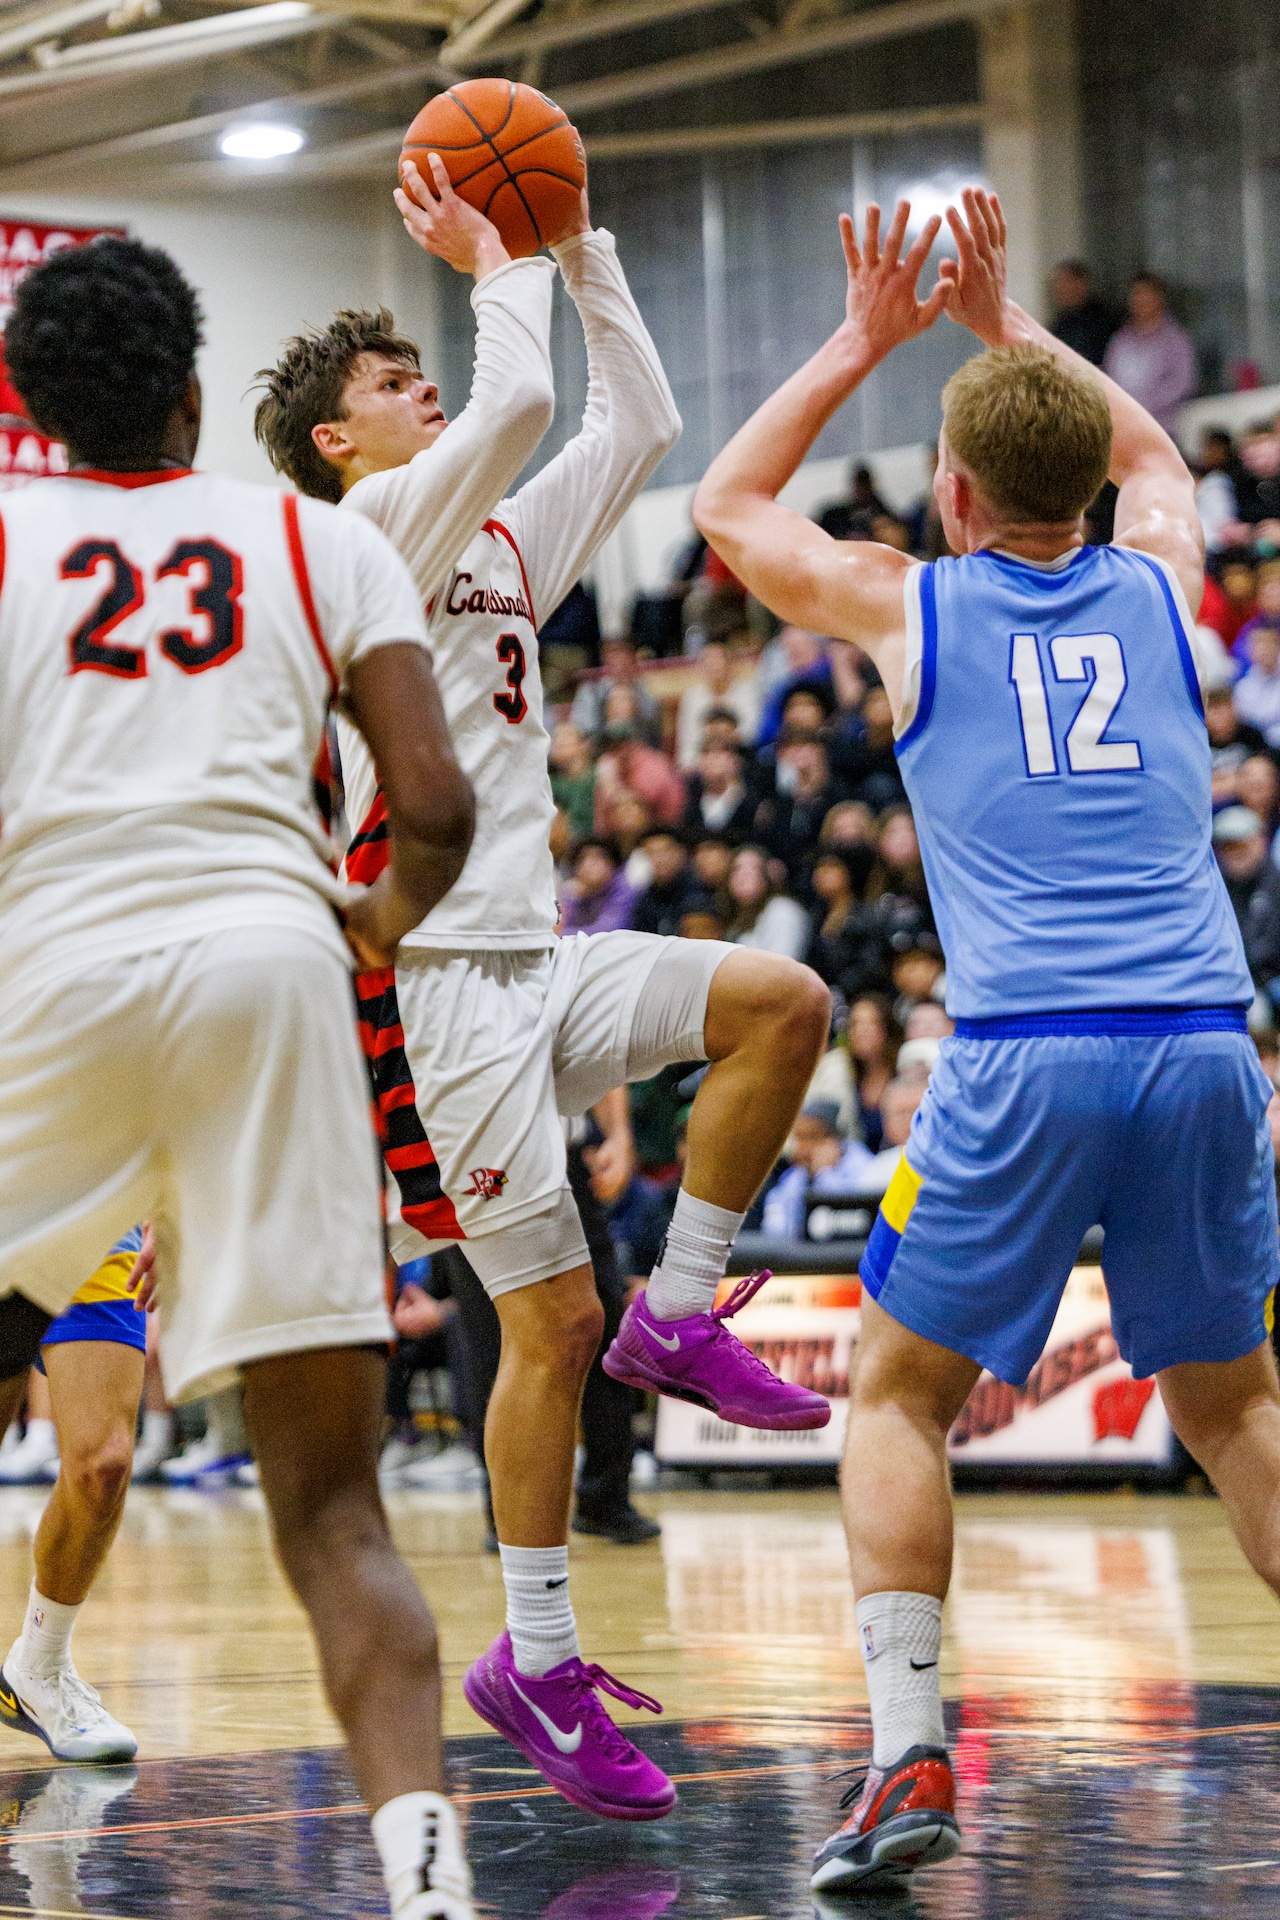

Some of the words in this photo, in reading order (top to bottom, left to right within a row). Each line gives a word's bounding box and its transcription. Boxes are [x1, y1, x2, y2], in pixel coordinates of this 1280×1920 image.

[57, 535, 244, 680] 23
[493, 633, 529, 725] 3
[1008, 632, 1145, 779] 12
